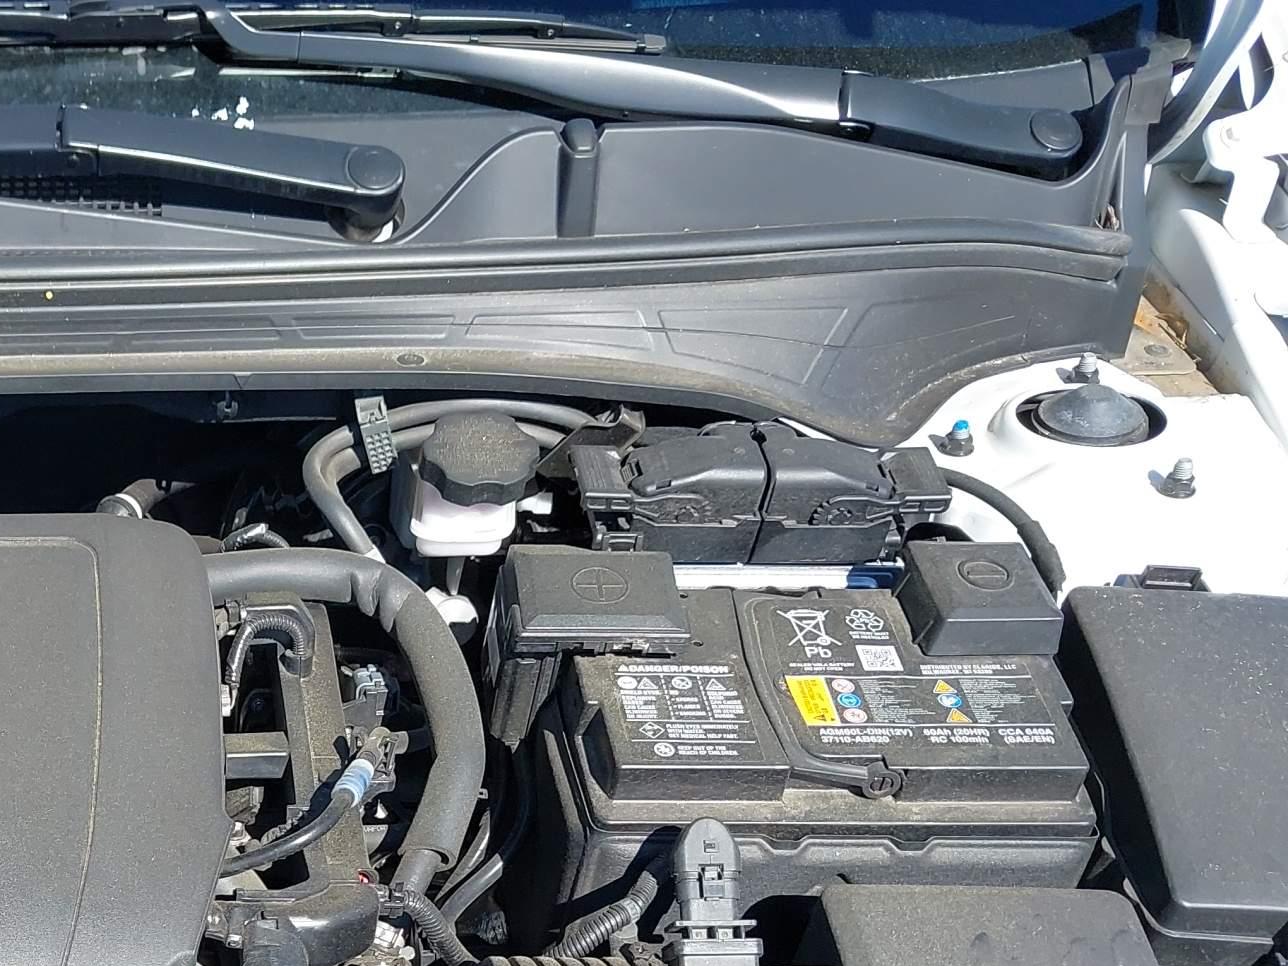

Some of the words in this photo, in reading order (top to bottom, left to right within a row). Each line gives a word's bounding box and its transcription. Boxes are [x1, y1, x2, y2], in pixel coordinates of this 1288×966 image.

[804, 646, 832, 658] Pb
[998, 728, 1023, 736] CCA
[931, 736, 948, 744] RC
